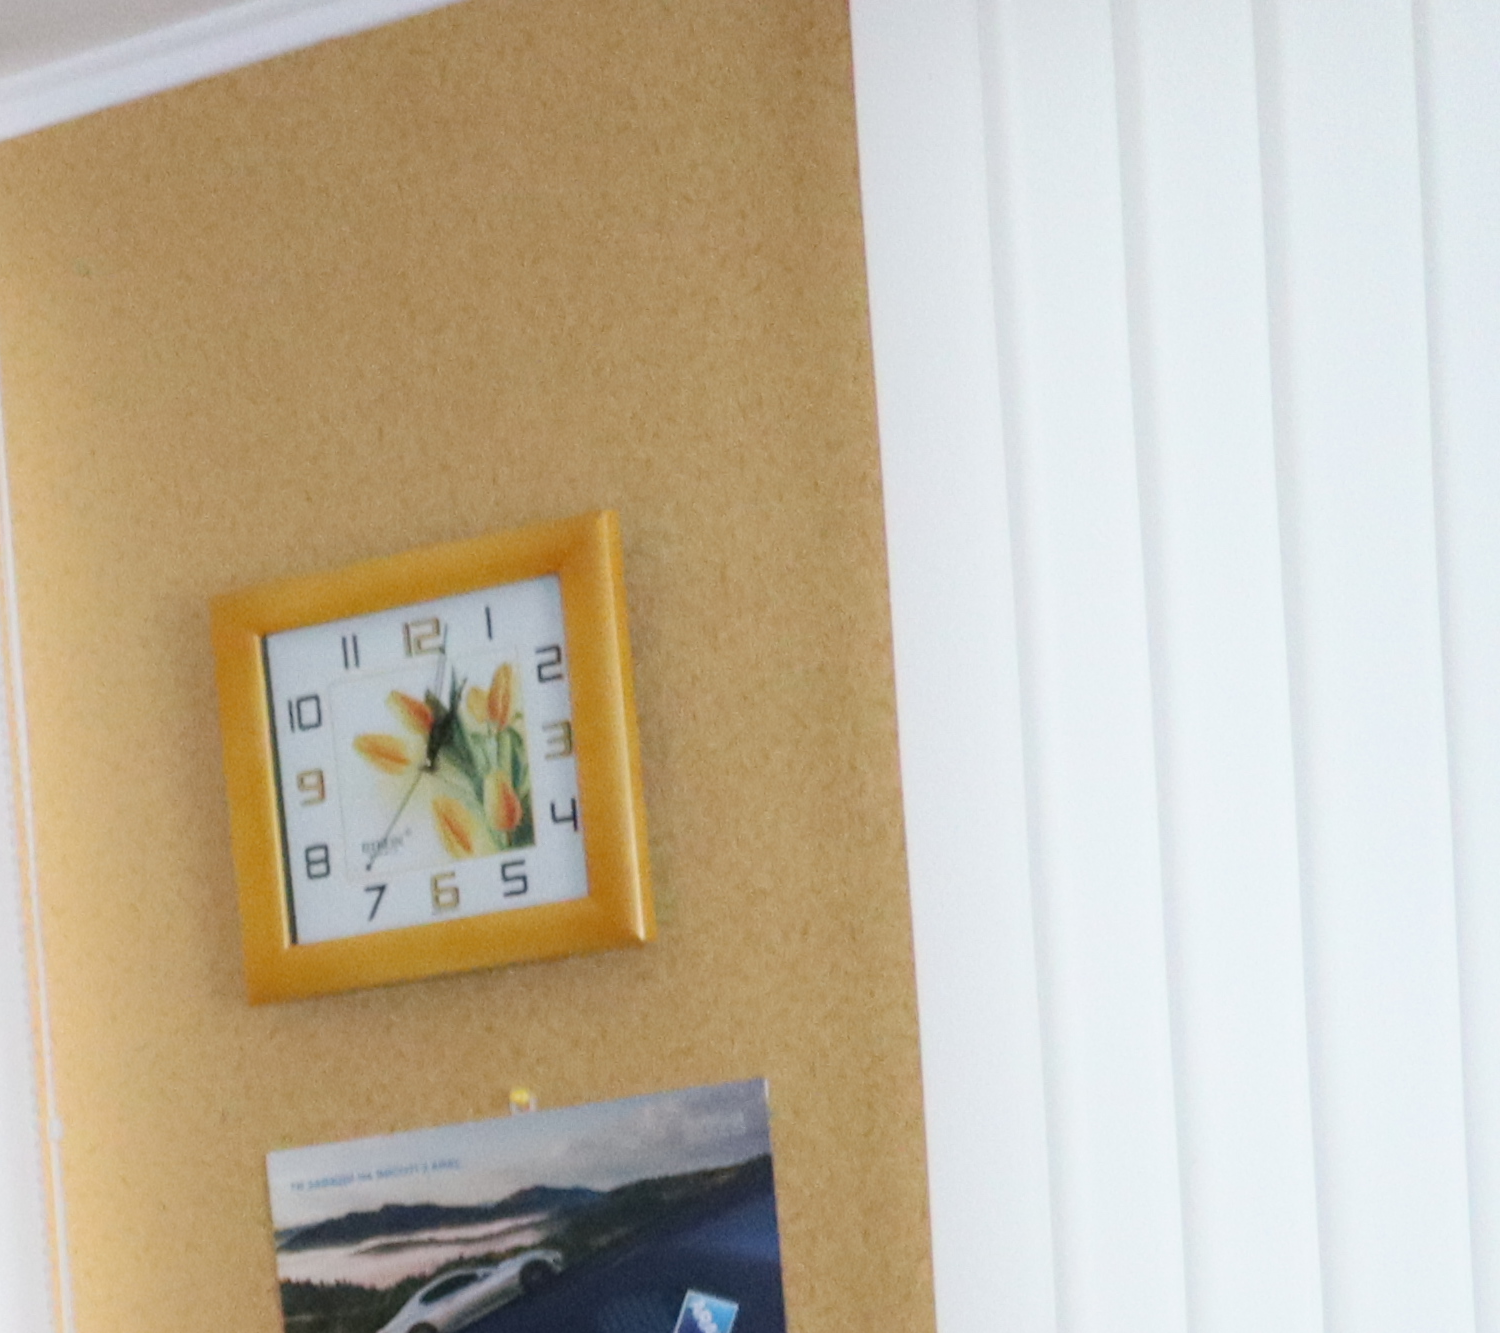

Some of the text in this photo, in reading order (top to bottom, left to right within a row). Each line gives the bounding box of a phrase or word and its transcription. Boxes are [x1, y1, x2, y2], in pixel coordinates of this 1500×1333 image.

[403, 617, 445, 657] 12
[485, 606, 493, 640] 1
[342, 633, 359, 670] 11
[535, 643, 563, 683] 2
[288, 694, 322, 733] 10
[542, 720, 573, 761] 3
[297, 769, 326, 807] 9
[551, 798, 578, 832] 4
[305, 844, 331, 880] 8
[501, 859, 528, 898] 5
[364, 884, 387, 921] 7
[430, 872, 460, 912] 6
